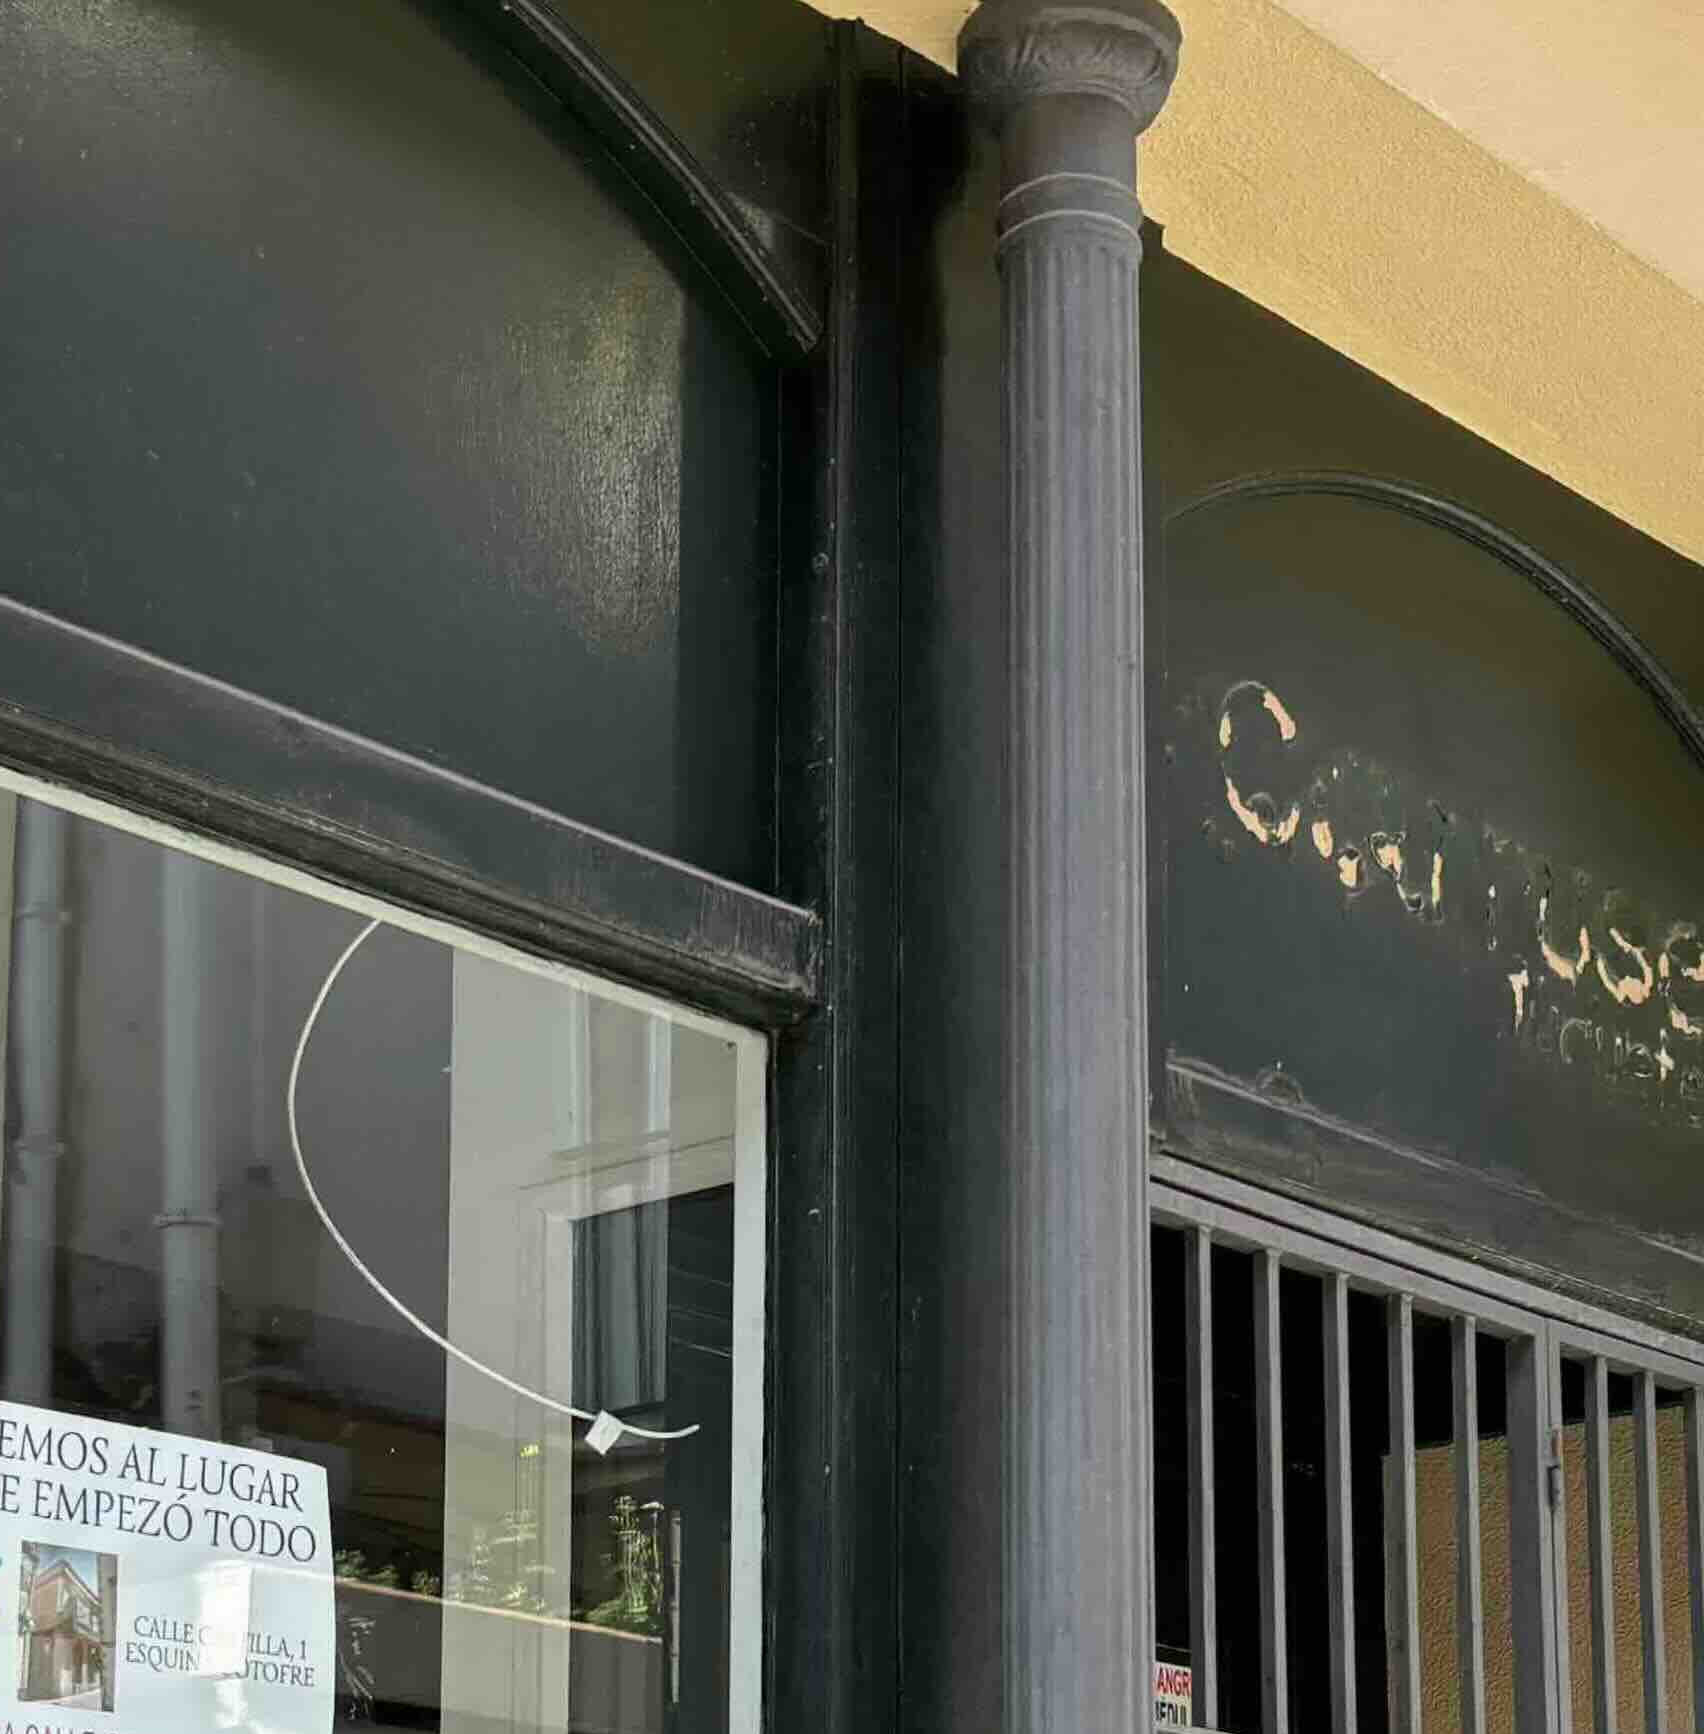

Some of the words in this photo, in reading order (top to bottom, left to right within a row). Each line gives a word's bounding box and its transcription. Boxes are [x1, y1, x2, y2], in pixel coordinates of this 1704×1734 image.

[118, 1442, 167, 1487] AL
[177, 1453, 303, 1513] LUGAR
[32, 1479, 193, 1542] EMPEZÓ
[204, 1508, 317, 1562] TODO
[134, 1615, 194, 1644] CALLE
[126, 1641, 200, 1672] ESQUIN
